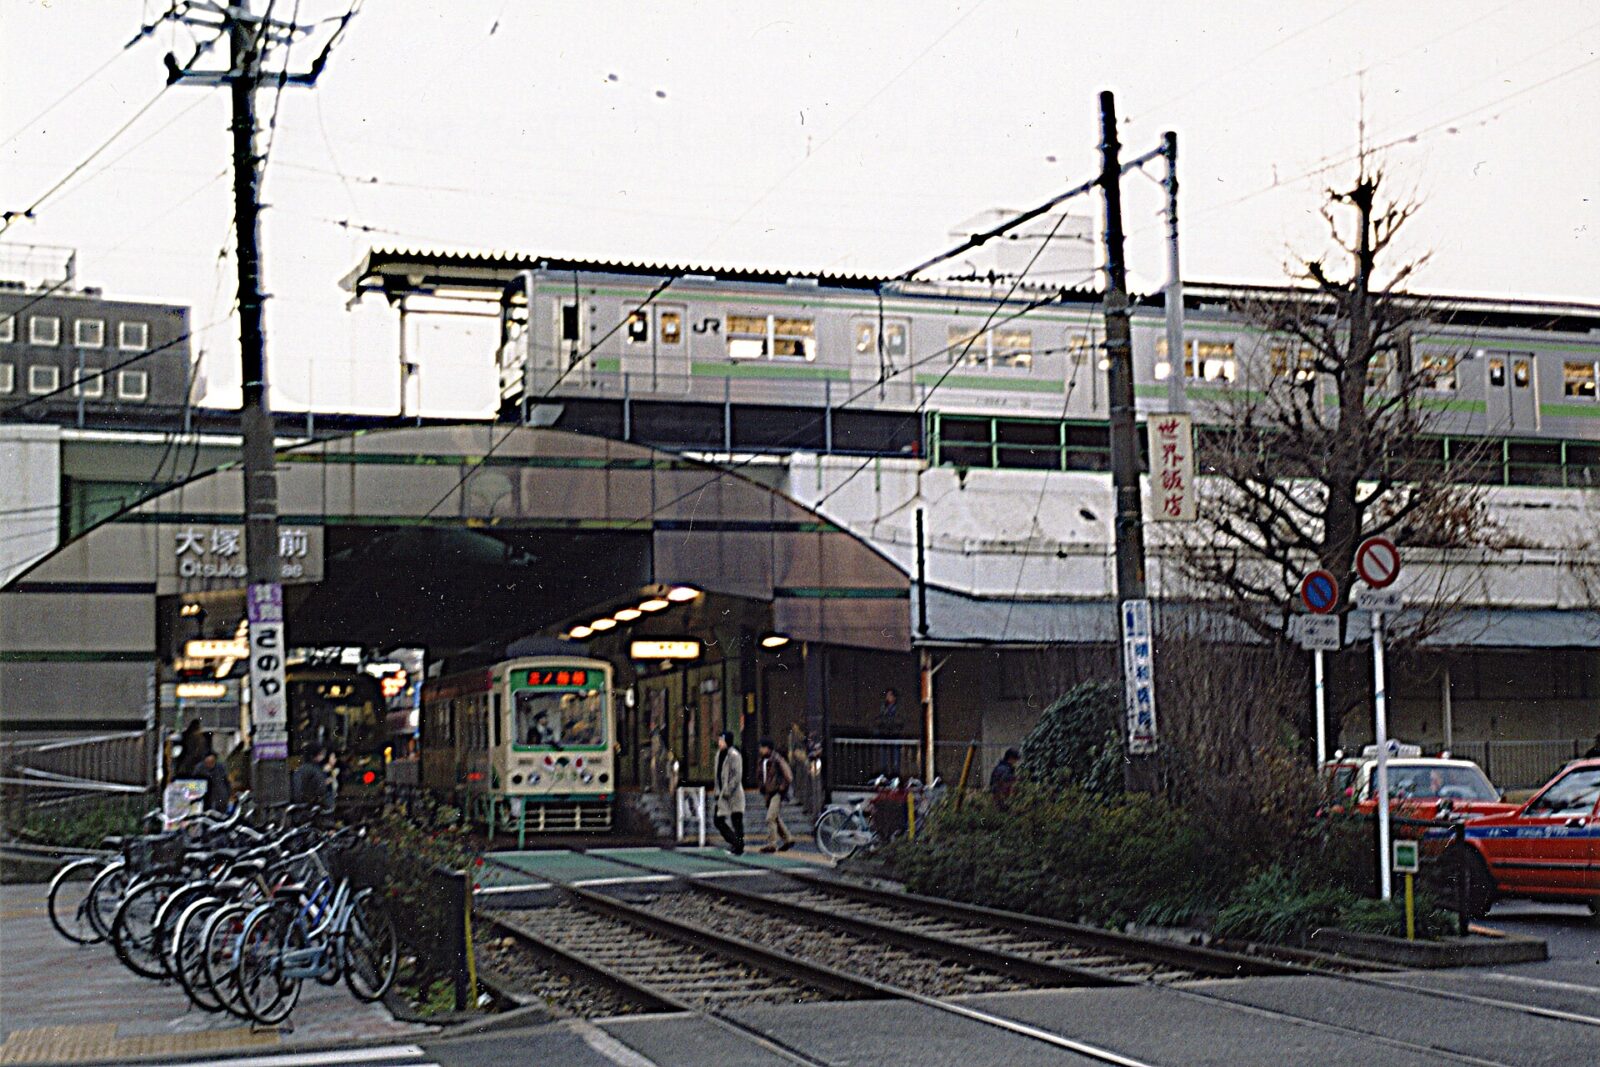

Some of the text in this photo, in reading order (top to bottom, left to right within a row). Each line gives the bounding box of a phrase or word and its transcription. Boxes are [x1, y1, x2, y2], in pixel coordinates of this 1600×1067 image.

[693, 318, 720, 334] JR
[1157, 417, 1185, 517] 世界飯店
[175, 527, 308, 557] 大塚前
